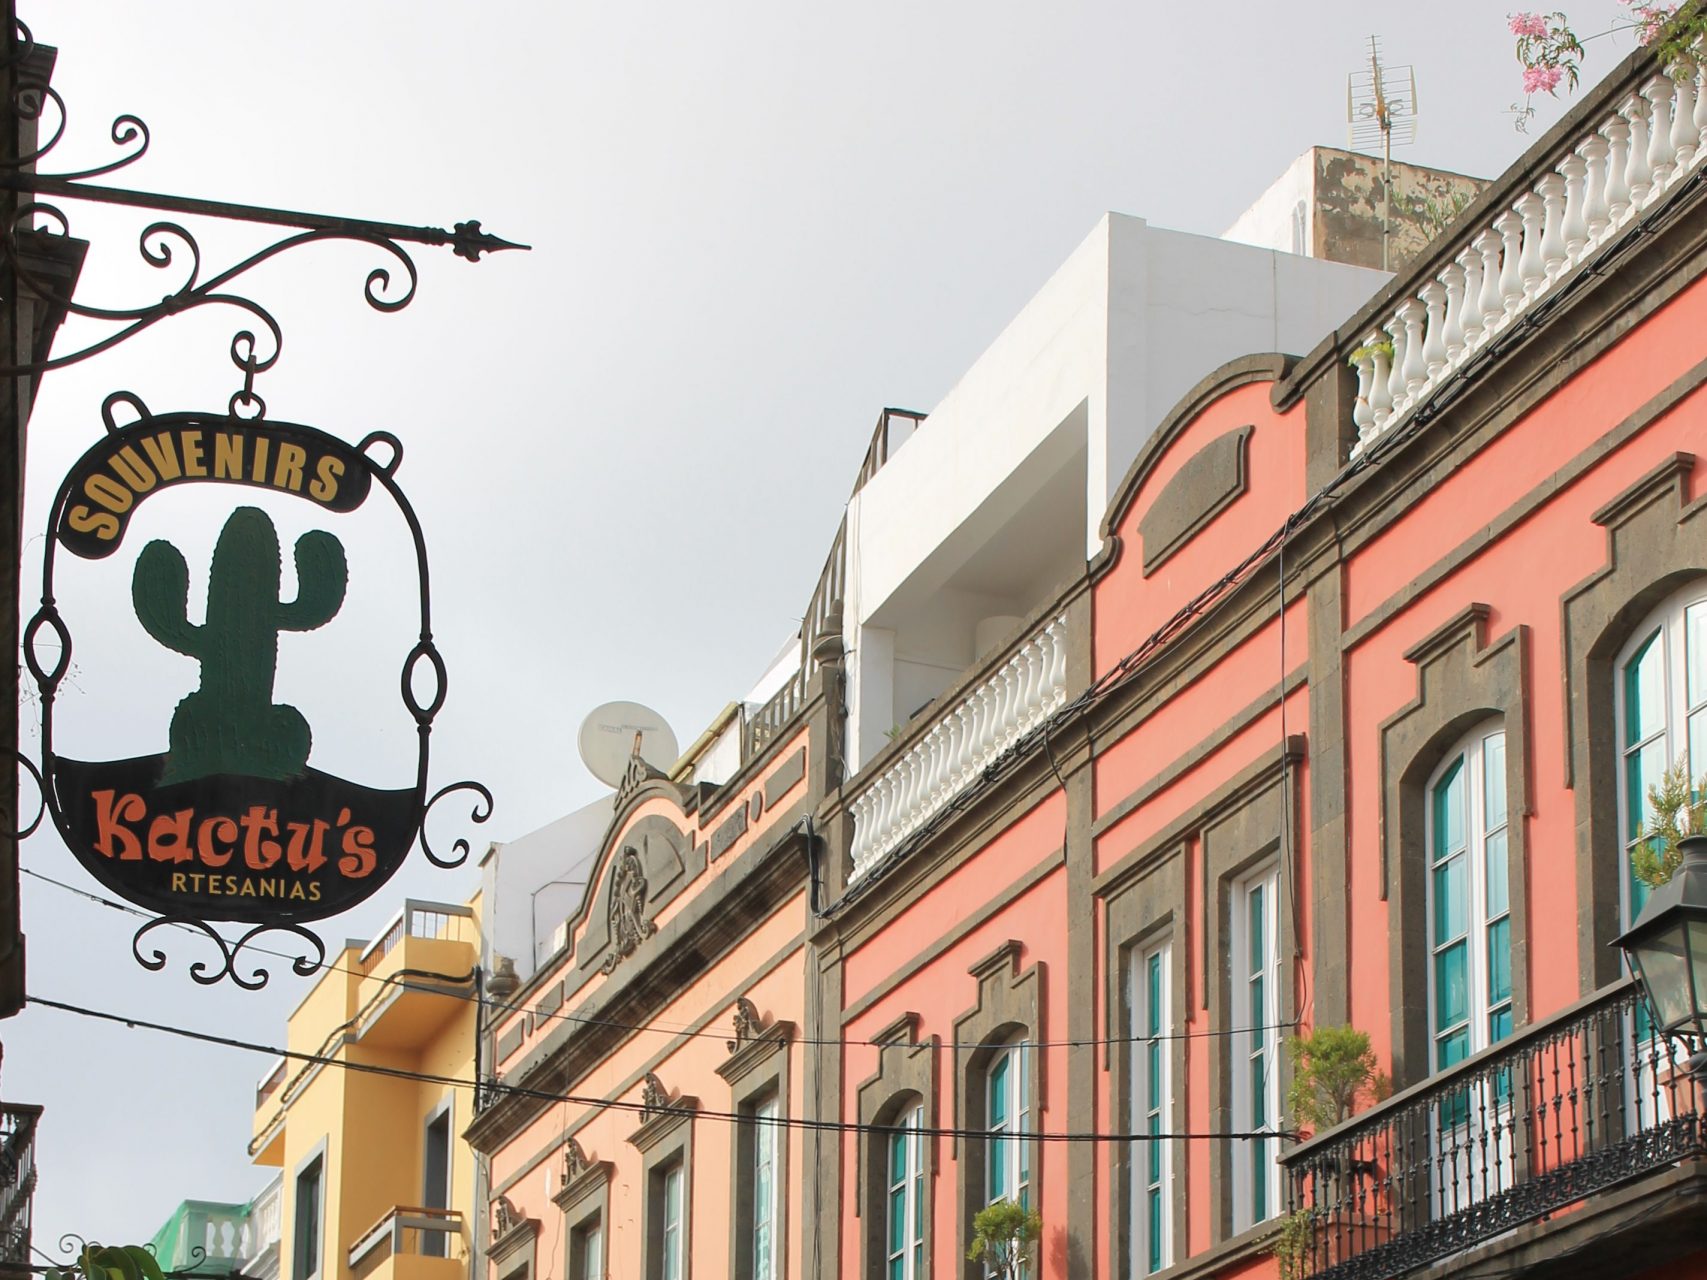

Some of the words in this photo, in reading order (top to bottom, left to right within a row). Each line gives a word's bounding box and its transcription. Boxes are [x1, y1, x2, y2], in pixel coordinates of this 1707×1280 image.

[69, 431, 345, 540] SOUVENIRS
[92, 790, 377, 878] Kactu's
[172, 873, 321, 901] RTESANIAS
